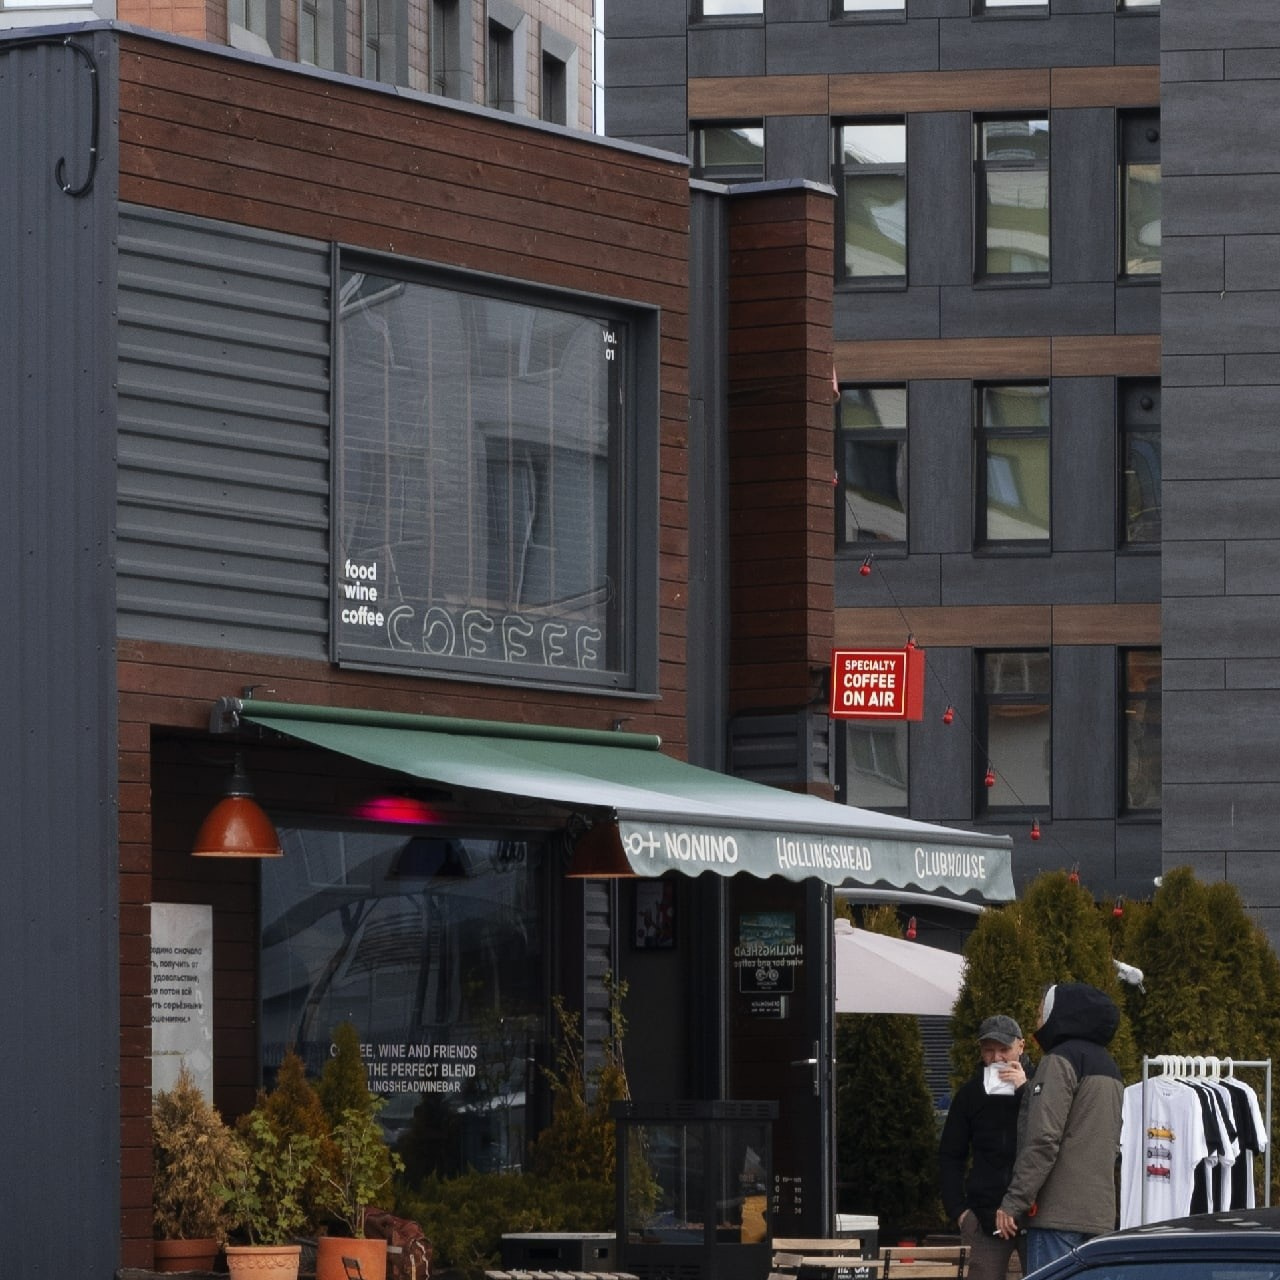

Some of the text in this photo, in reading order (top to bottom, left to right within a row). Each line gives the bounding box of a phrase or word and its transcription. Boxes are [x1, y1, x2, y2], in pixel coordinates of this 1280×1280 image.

[602, 330, 617, 344] Vol.
[605, 348, 615, 361] 01
[344, 559, 377, 581] food
[344, 582, 378, 602] wine
[341, 607, 385, 627] coffee
[844, 659, 897, 671] SPECIALTY
[843, 673, 896, 689] COFFEE
[843, 690, 895, 707] ON AIR
[664, 831, 986, 879] NONINO HOLLINGSHEAD CLUBHOUSE
[378, 1044, 406, 1058] WINE
[408, 1044, 431, 1058] AND
[433, 1044, 478, 1060] FRIENDS
[367, 1062, 476, 1078] THE PERFECT BLEND
[367, 1081, 461, 1093] LINGSHEADWINEBAR
